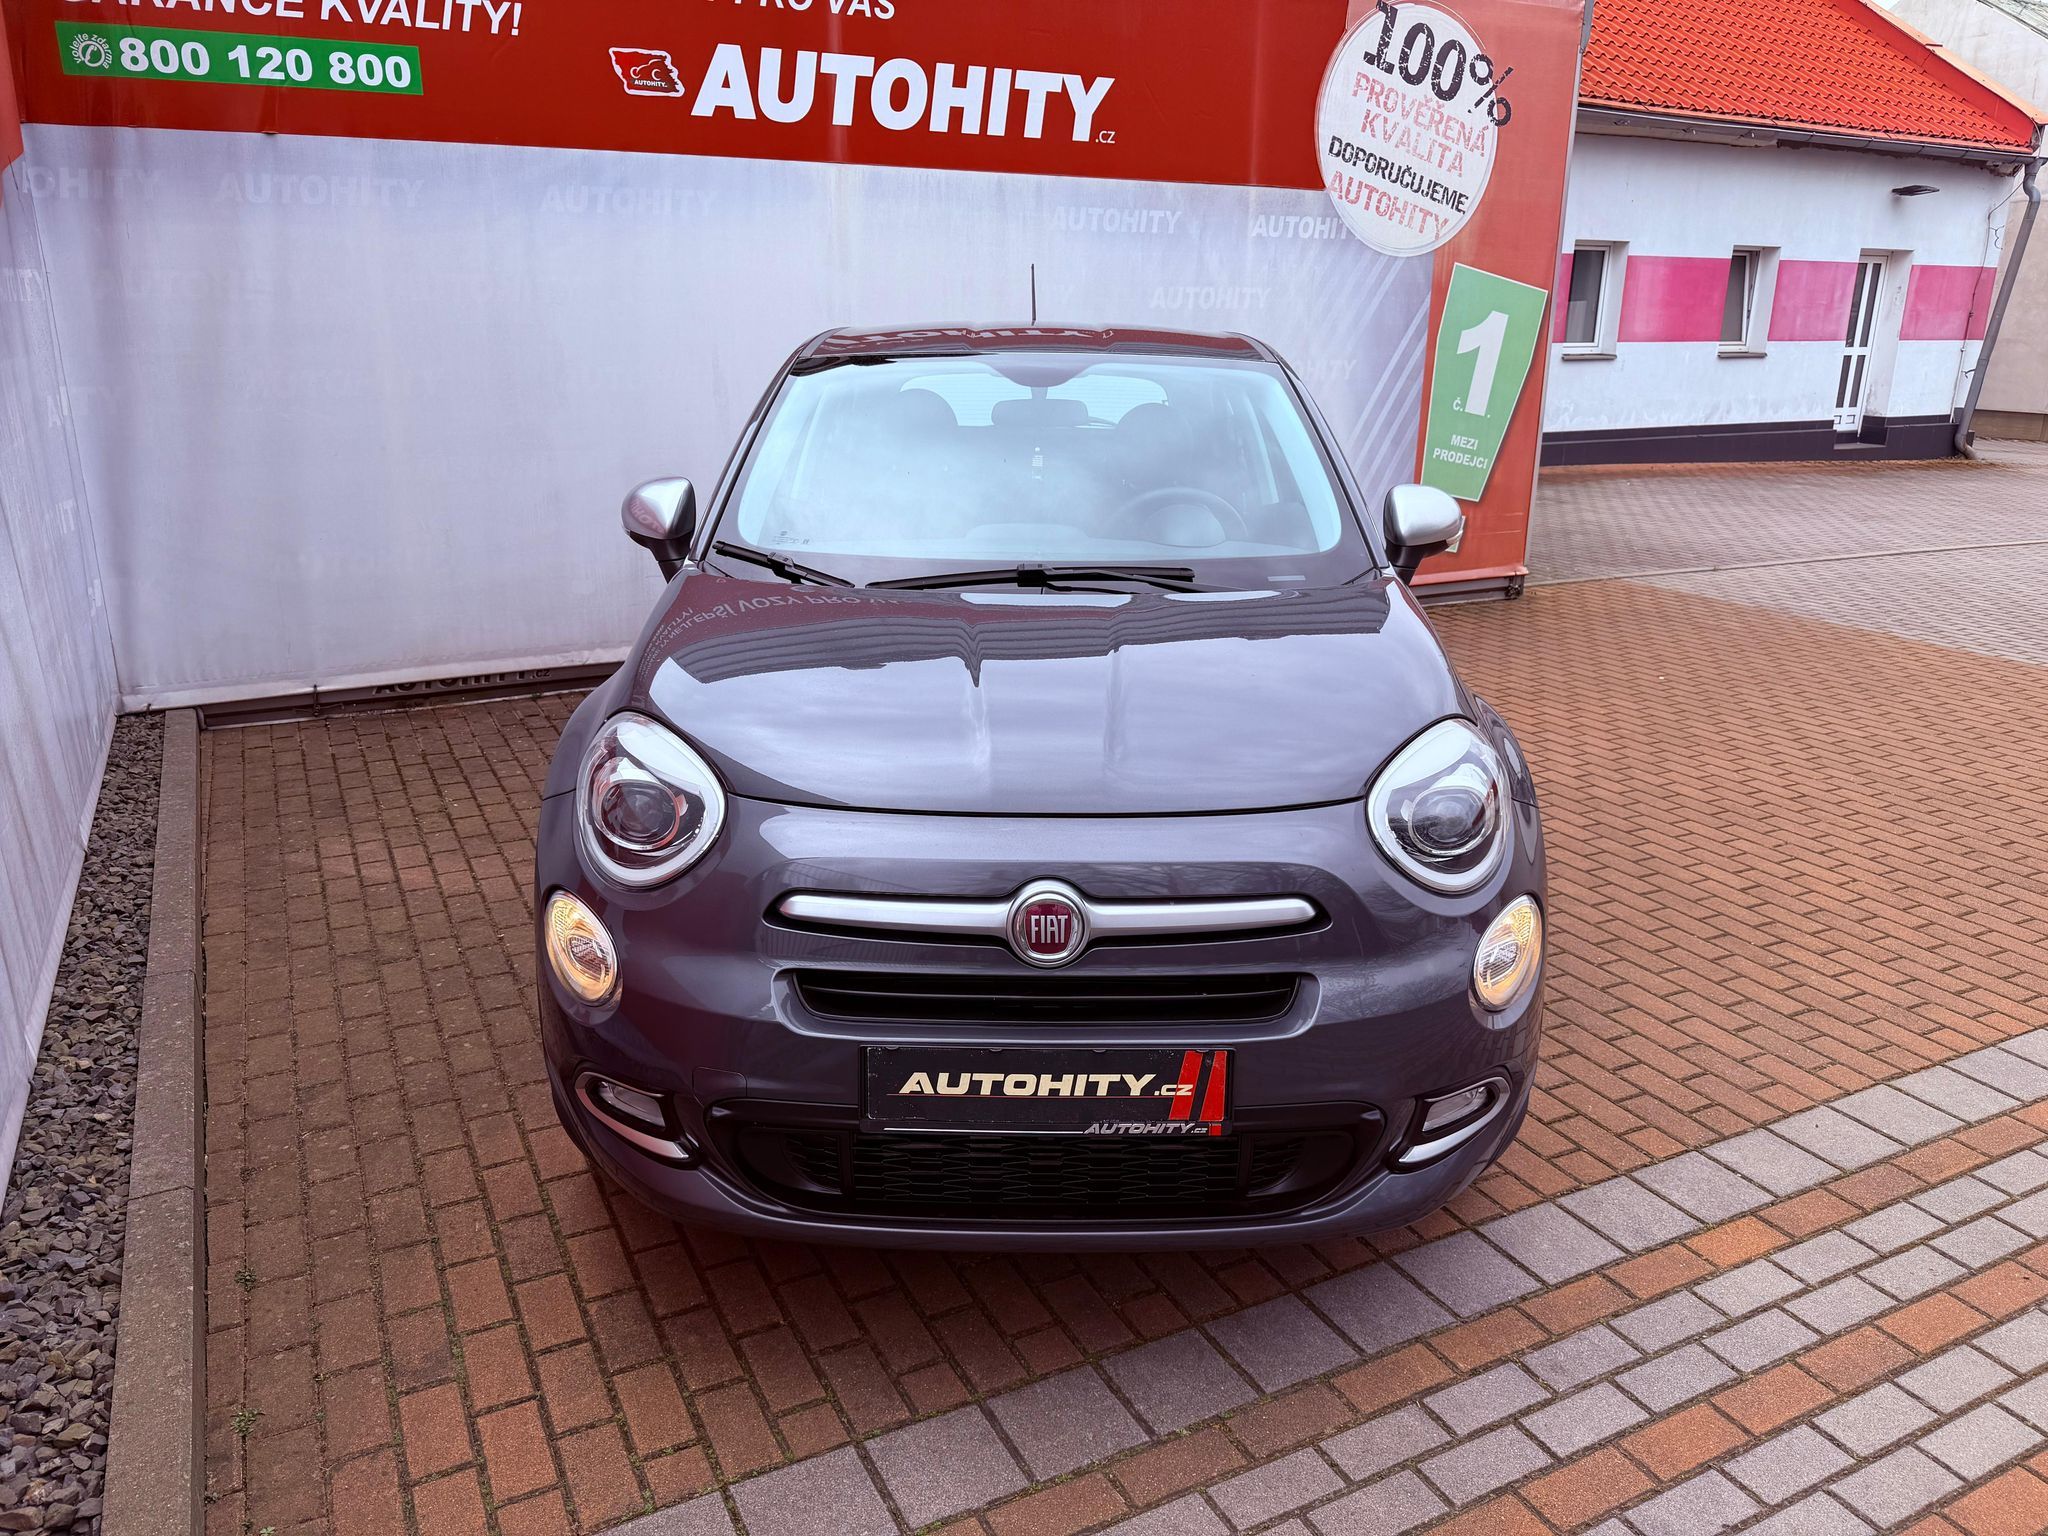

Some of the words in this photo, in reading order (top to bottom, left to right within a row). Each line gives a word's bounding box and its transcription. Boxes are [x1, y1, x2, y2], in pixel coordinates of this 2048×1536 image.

[91, 34, 113, 69] zdarma
[119, 37, 210, 76] 800
[228, 44, 313, 82] 120
[328, 51, 411, 88] 800
[1363, 0, 1514, 127] 100%
[1352, 72, 1488, 157] PROVĚŘENÁ
[1361, 109, 1464, 177] KVALITA
[1328, 136, 1469, 215] DOPORUČUJEME
[1054, 206, 1182, 235] AUTOHITY
[1329, 171, 1450, 240] AUTOHITY
[1252, 213, 1360, 241] AUTOHIT
[1150, 287, 1271, 311] AUTOHITY
[1433, 448, 1488, 469] PRODEJCI
[1450, 434, 1479, 451] MEZI
[1030, 915, 1068, 944] FIAT
